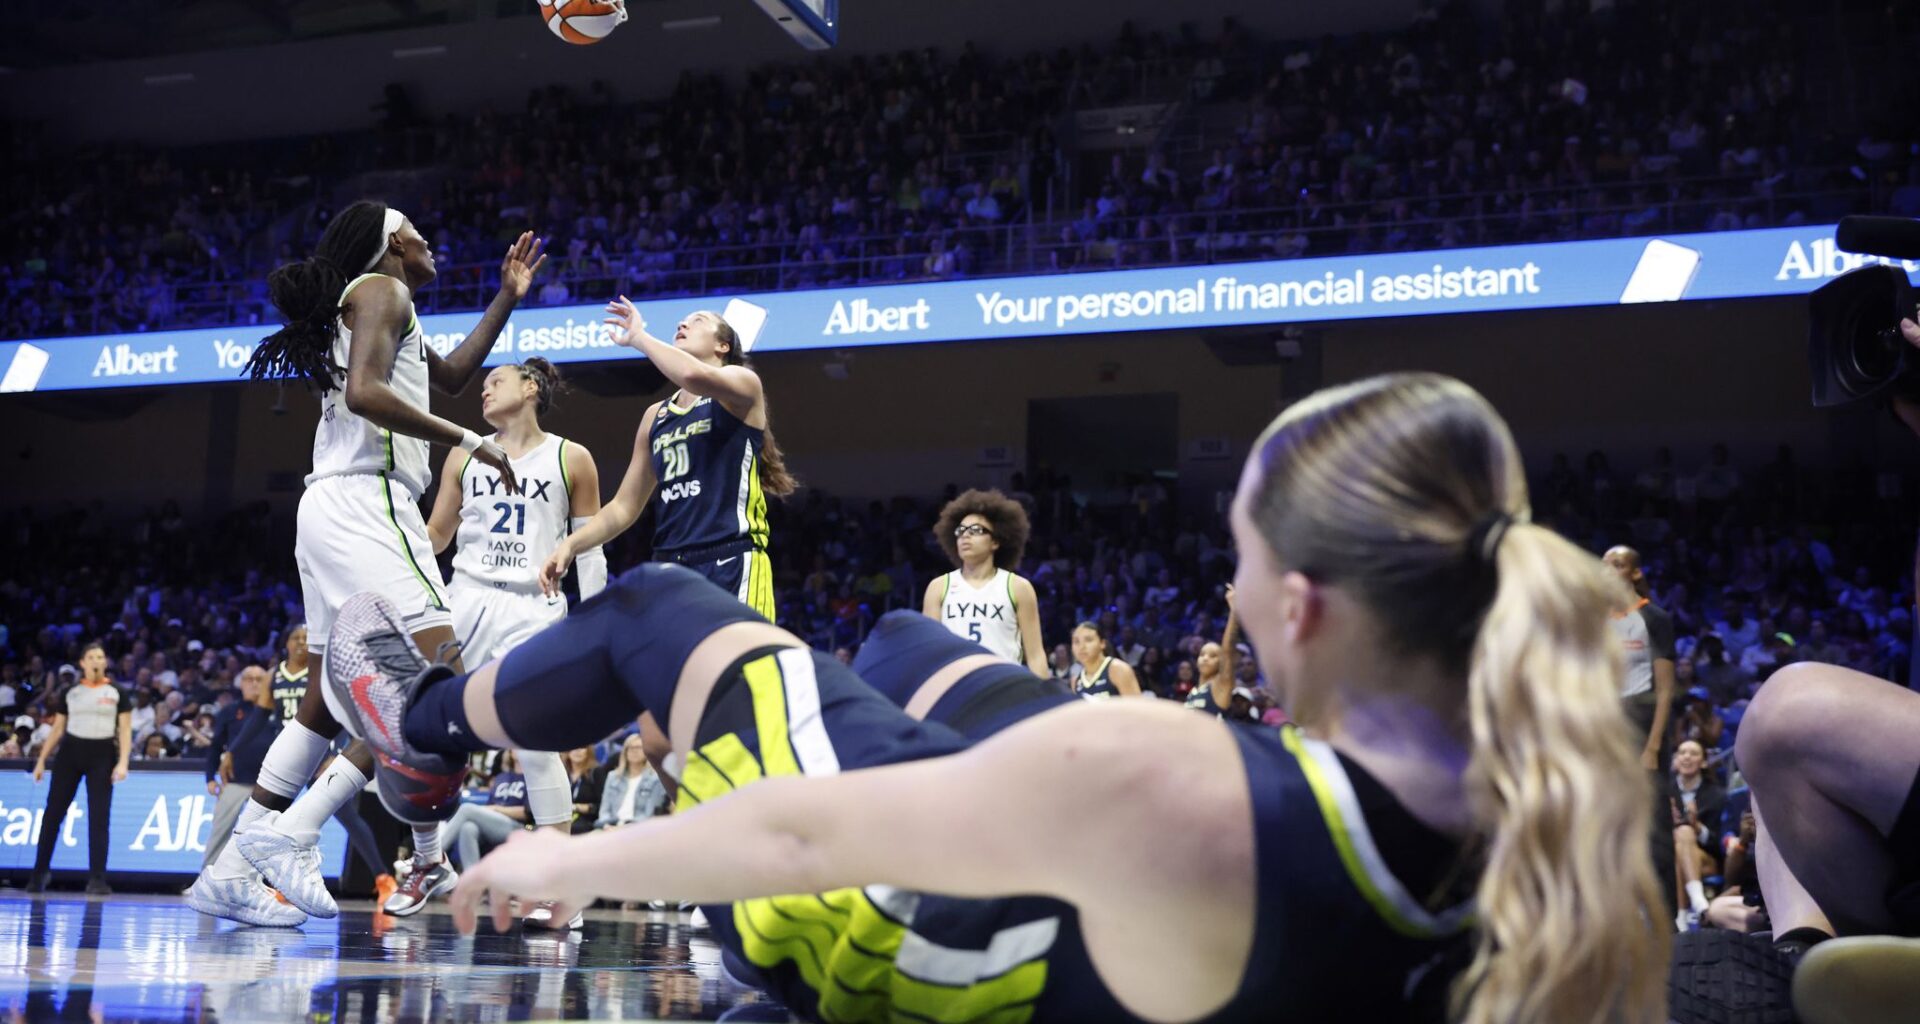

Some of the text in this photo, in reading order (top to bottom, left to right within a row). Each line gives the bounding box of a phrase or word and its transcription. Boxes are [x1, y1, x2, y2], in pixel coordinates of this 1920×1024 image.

[1775, 238, 1918, 280] Alb
[976, 262, 1541, 327] Your personal financial assistant
[822, 299, 930, 335] Albert
[91, 344, 178, 377] Albert
[653, 418, 712, 455] DALLAS
[663, 442, 690, 481] 20
[670, 480, 701, 500] CVS
[490, 502, 526, 535] 21
[481, 554, 528, 568] CLINIC
[947, 602, 1004, 621] LYNX
[968, 622, 982, 643] 5
[129, 794, 214, 851] Alb
